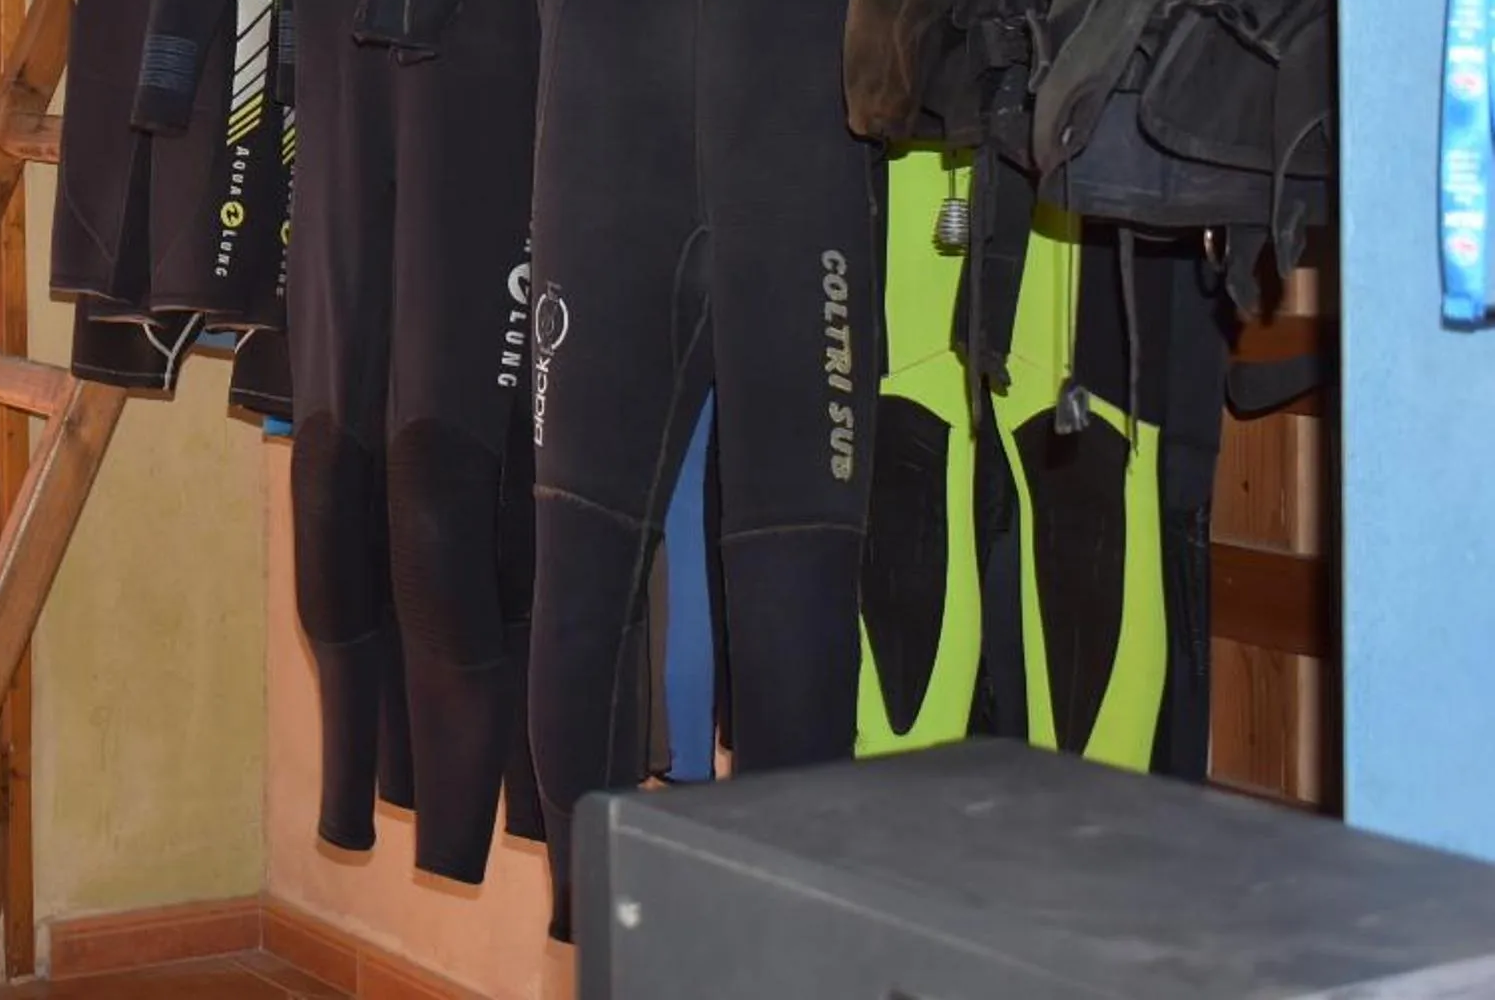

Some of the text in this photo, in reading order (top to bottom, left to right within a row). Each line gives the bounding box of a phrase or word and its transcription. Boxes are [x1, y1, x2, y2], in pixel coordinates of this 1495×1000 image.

[215, 145, 251, 279] AQUA LUNG
[497, 310, 528, 388] LUNG
[821, 249, 855, 482] COLTRI SUB
